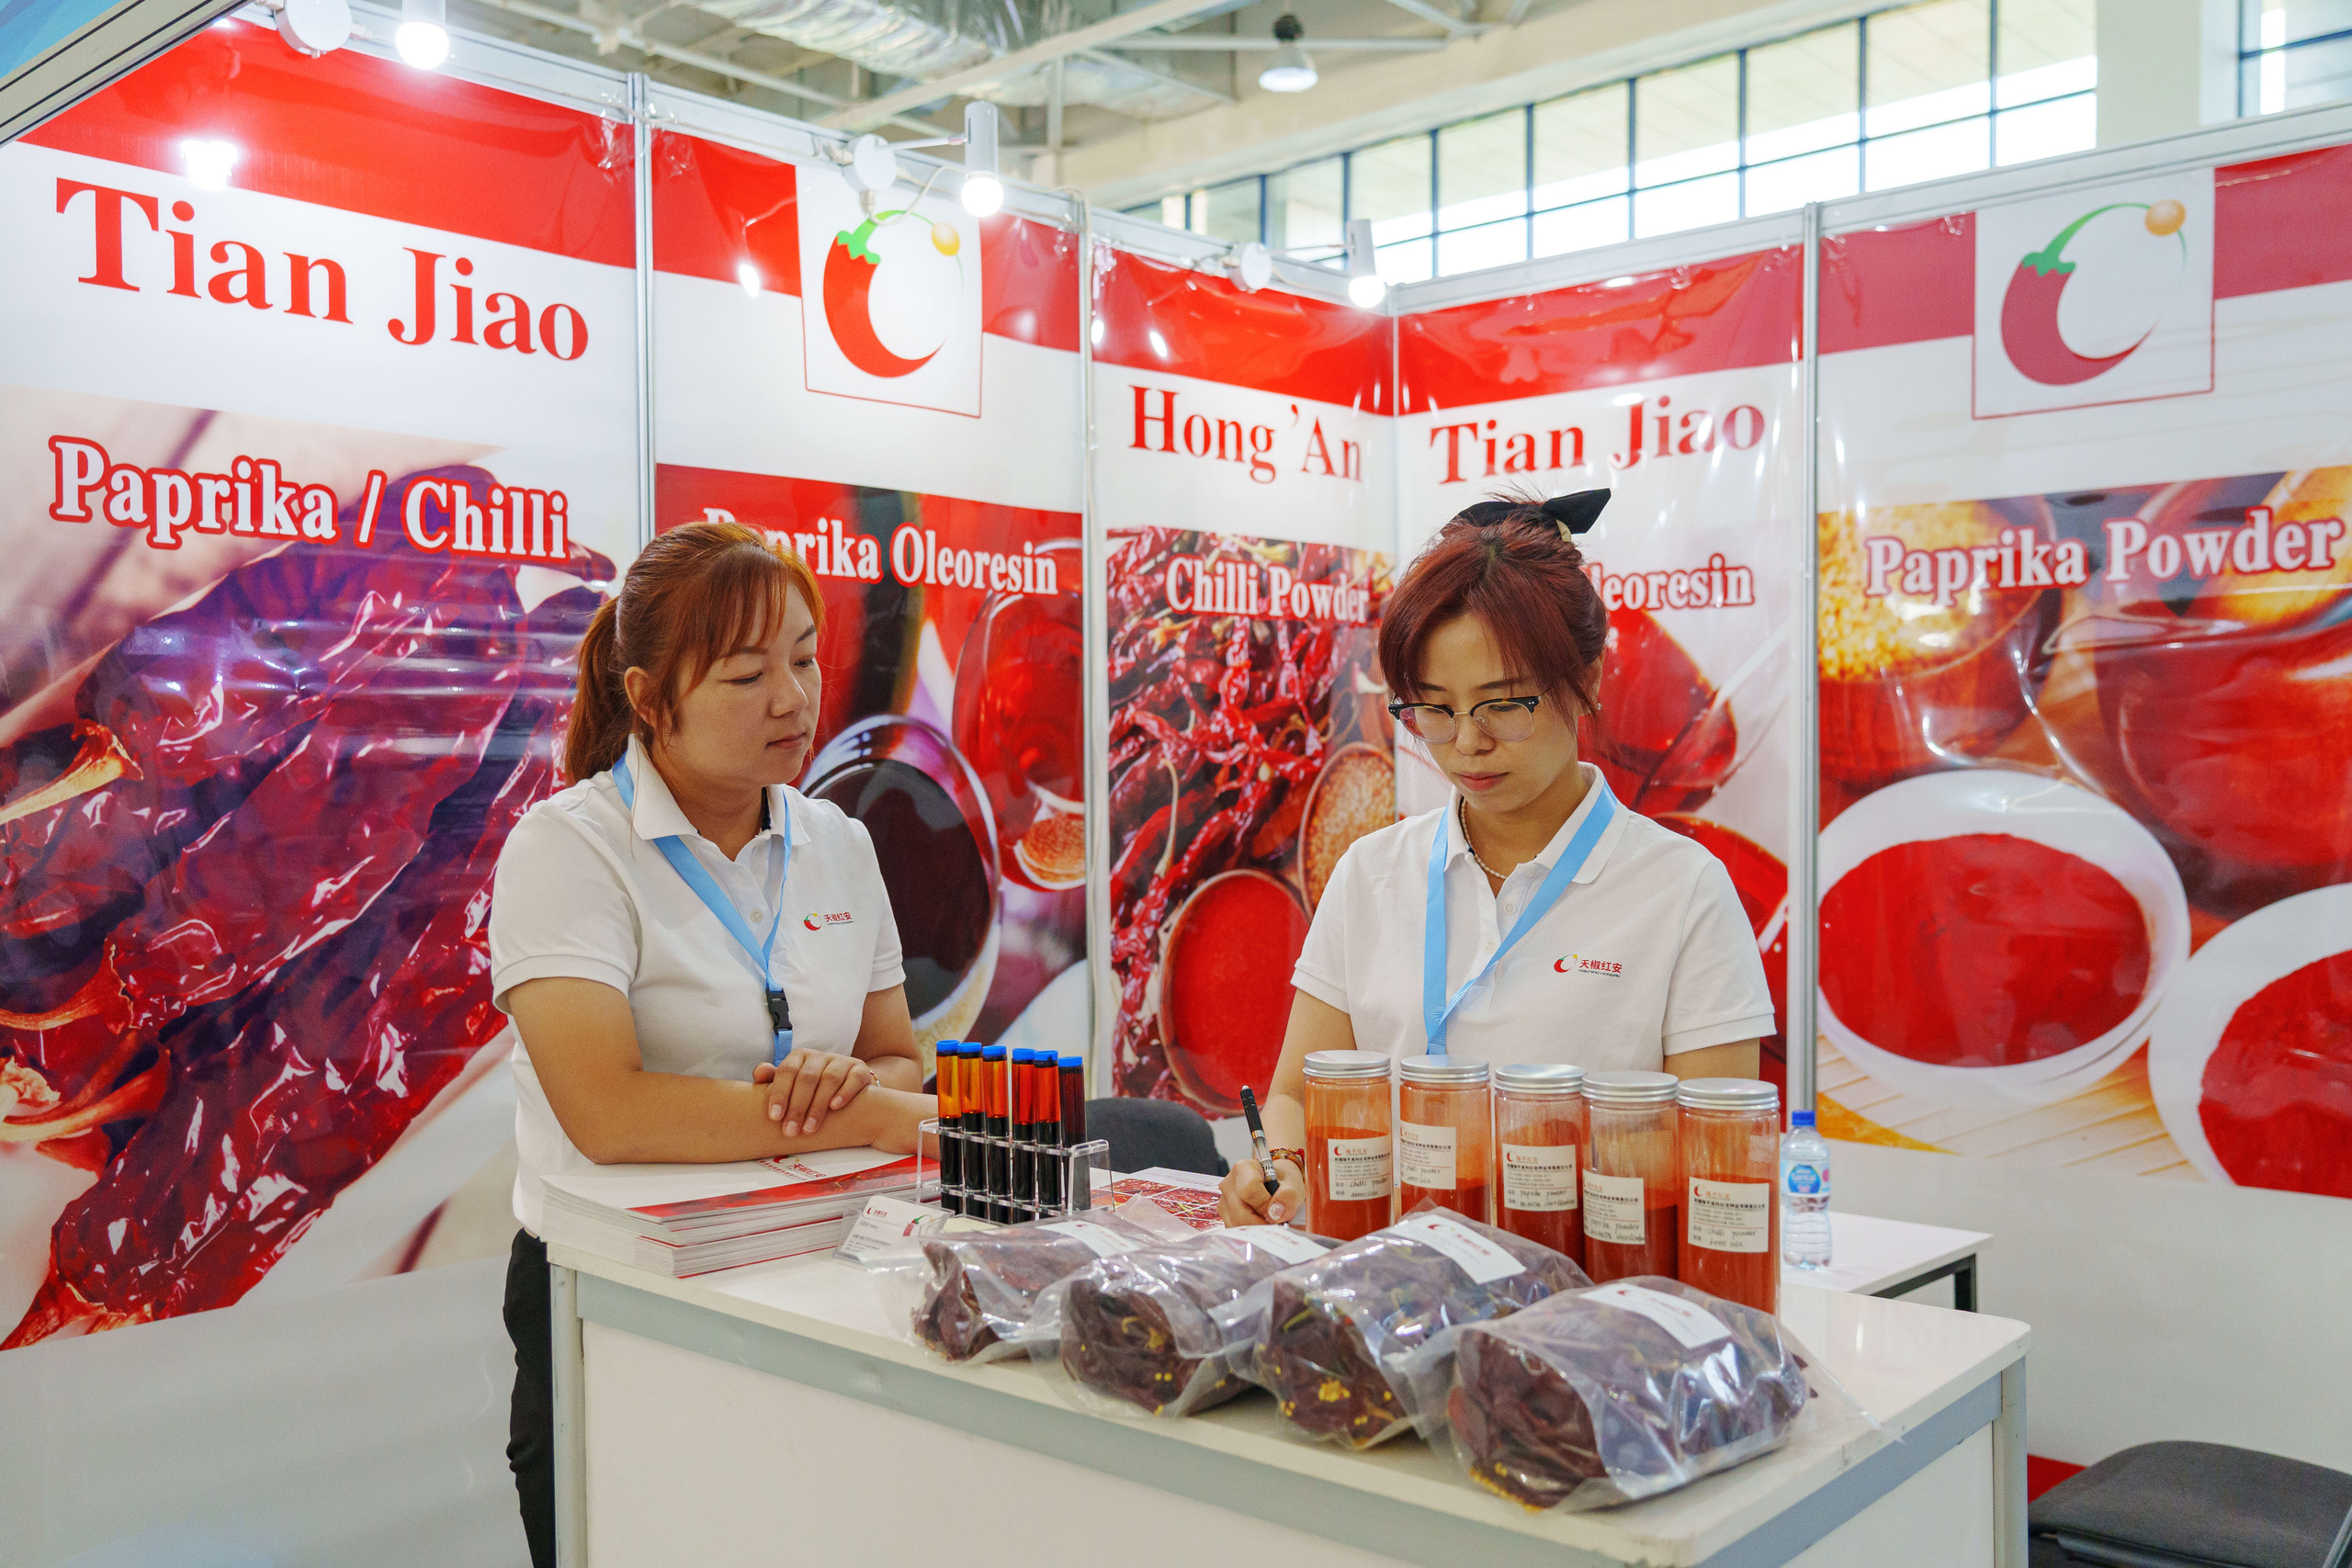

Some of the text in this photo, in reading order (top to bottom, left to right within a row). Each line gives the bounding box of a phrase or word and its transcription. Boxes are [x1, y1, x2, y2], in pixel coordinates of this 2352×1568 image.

[56, 176, 589, 361] Tian Jiao
[1128, 386, 1277, 484] Hong
[1429, 393, 1765, 486] Tian Jiao
[50, 436, 570, 560] Paprika / Chilli
[702, 507, 1059, 596] rika Oleoresin
[1165, 555, 1370, 625] Chilli Powder
[1589, 553, 1755, 611] leoresin
[1865, 506, 2343, 606] Paprika Powder
[1578, 959, 1623, 974] 天椒红安
[1732, 1230, 1758, 1240] powder
